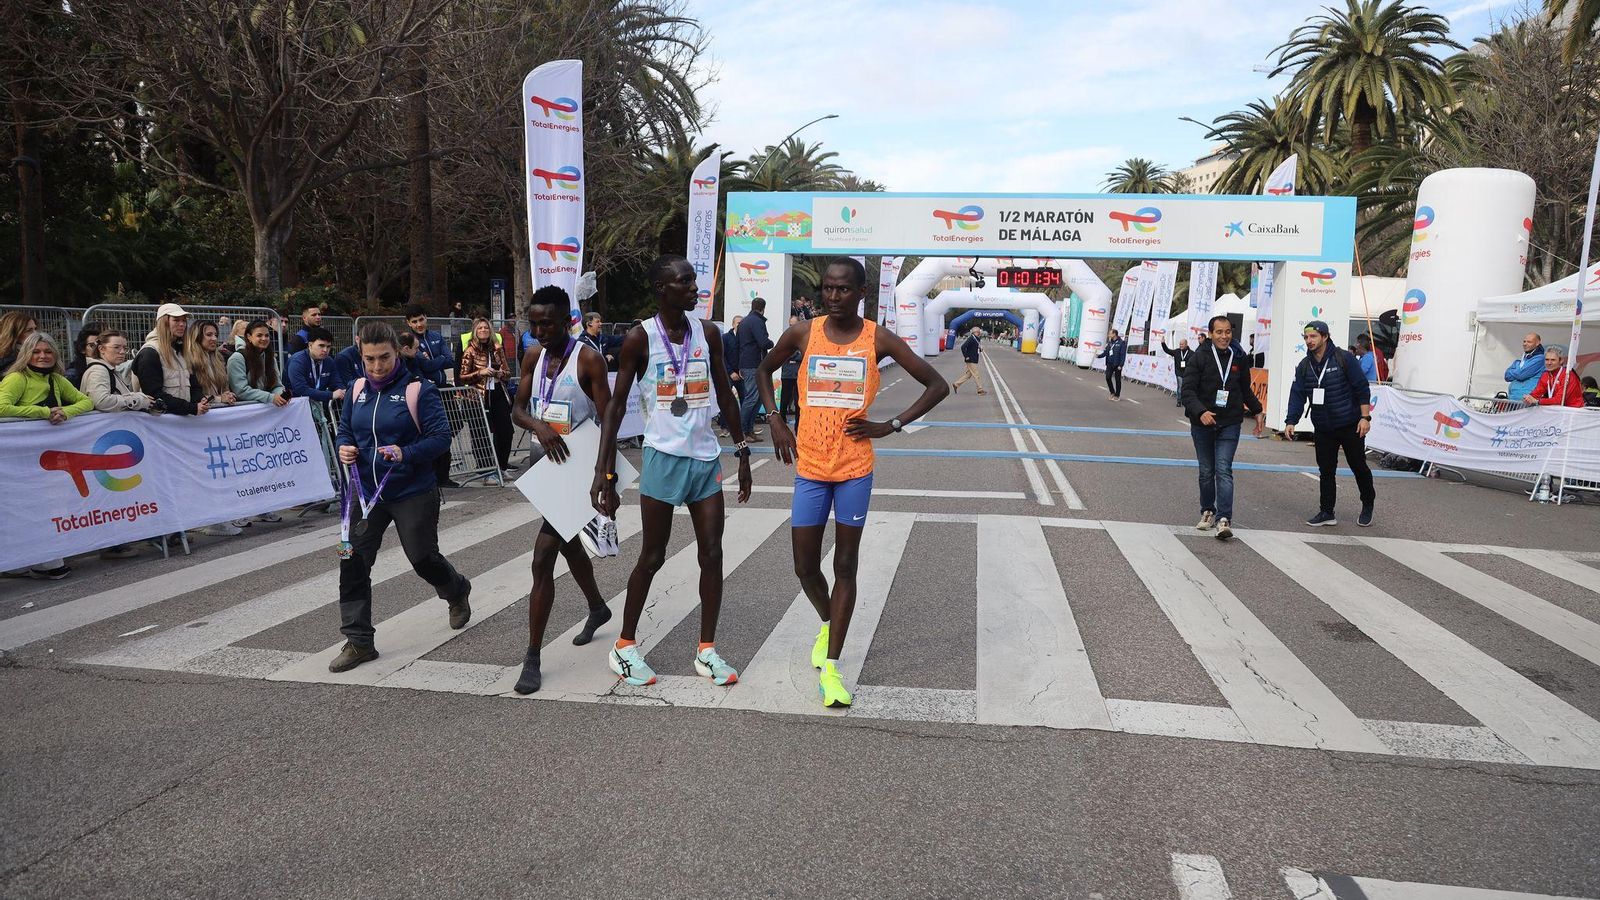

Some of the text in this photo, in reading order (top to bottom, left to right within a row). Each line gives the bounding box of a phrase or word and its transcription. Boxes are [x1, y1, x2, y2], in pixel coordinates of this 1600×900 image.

[531, 120, 580, 132] TotalEnergies
[999, 208, 1094, 224] 1/2 MARATÓN
[999, 226, 1082, 242] DE MÁLAGA
[1248, 222, 1300, 234] CaixaBank
[932, 235, 984, 244] TotalEnergies
[1108, 236, 1161, 246] TotalEnergies
[999, 271, 1060, 286] 01:01:34
[832, 380, 841, 392] 2
[232, 449, 308, 475] LasCarreras
[237, 480, 296, 498] totalenergies.es
[51, 501, 159, 532] TotalEnergies
